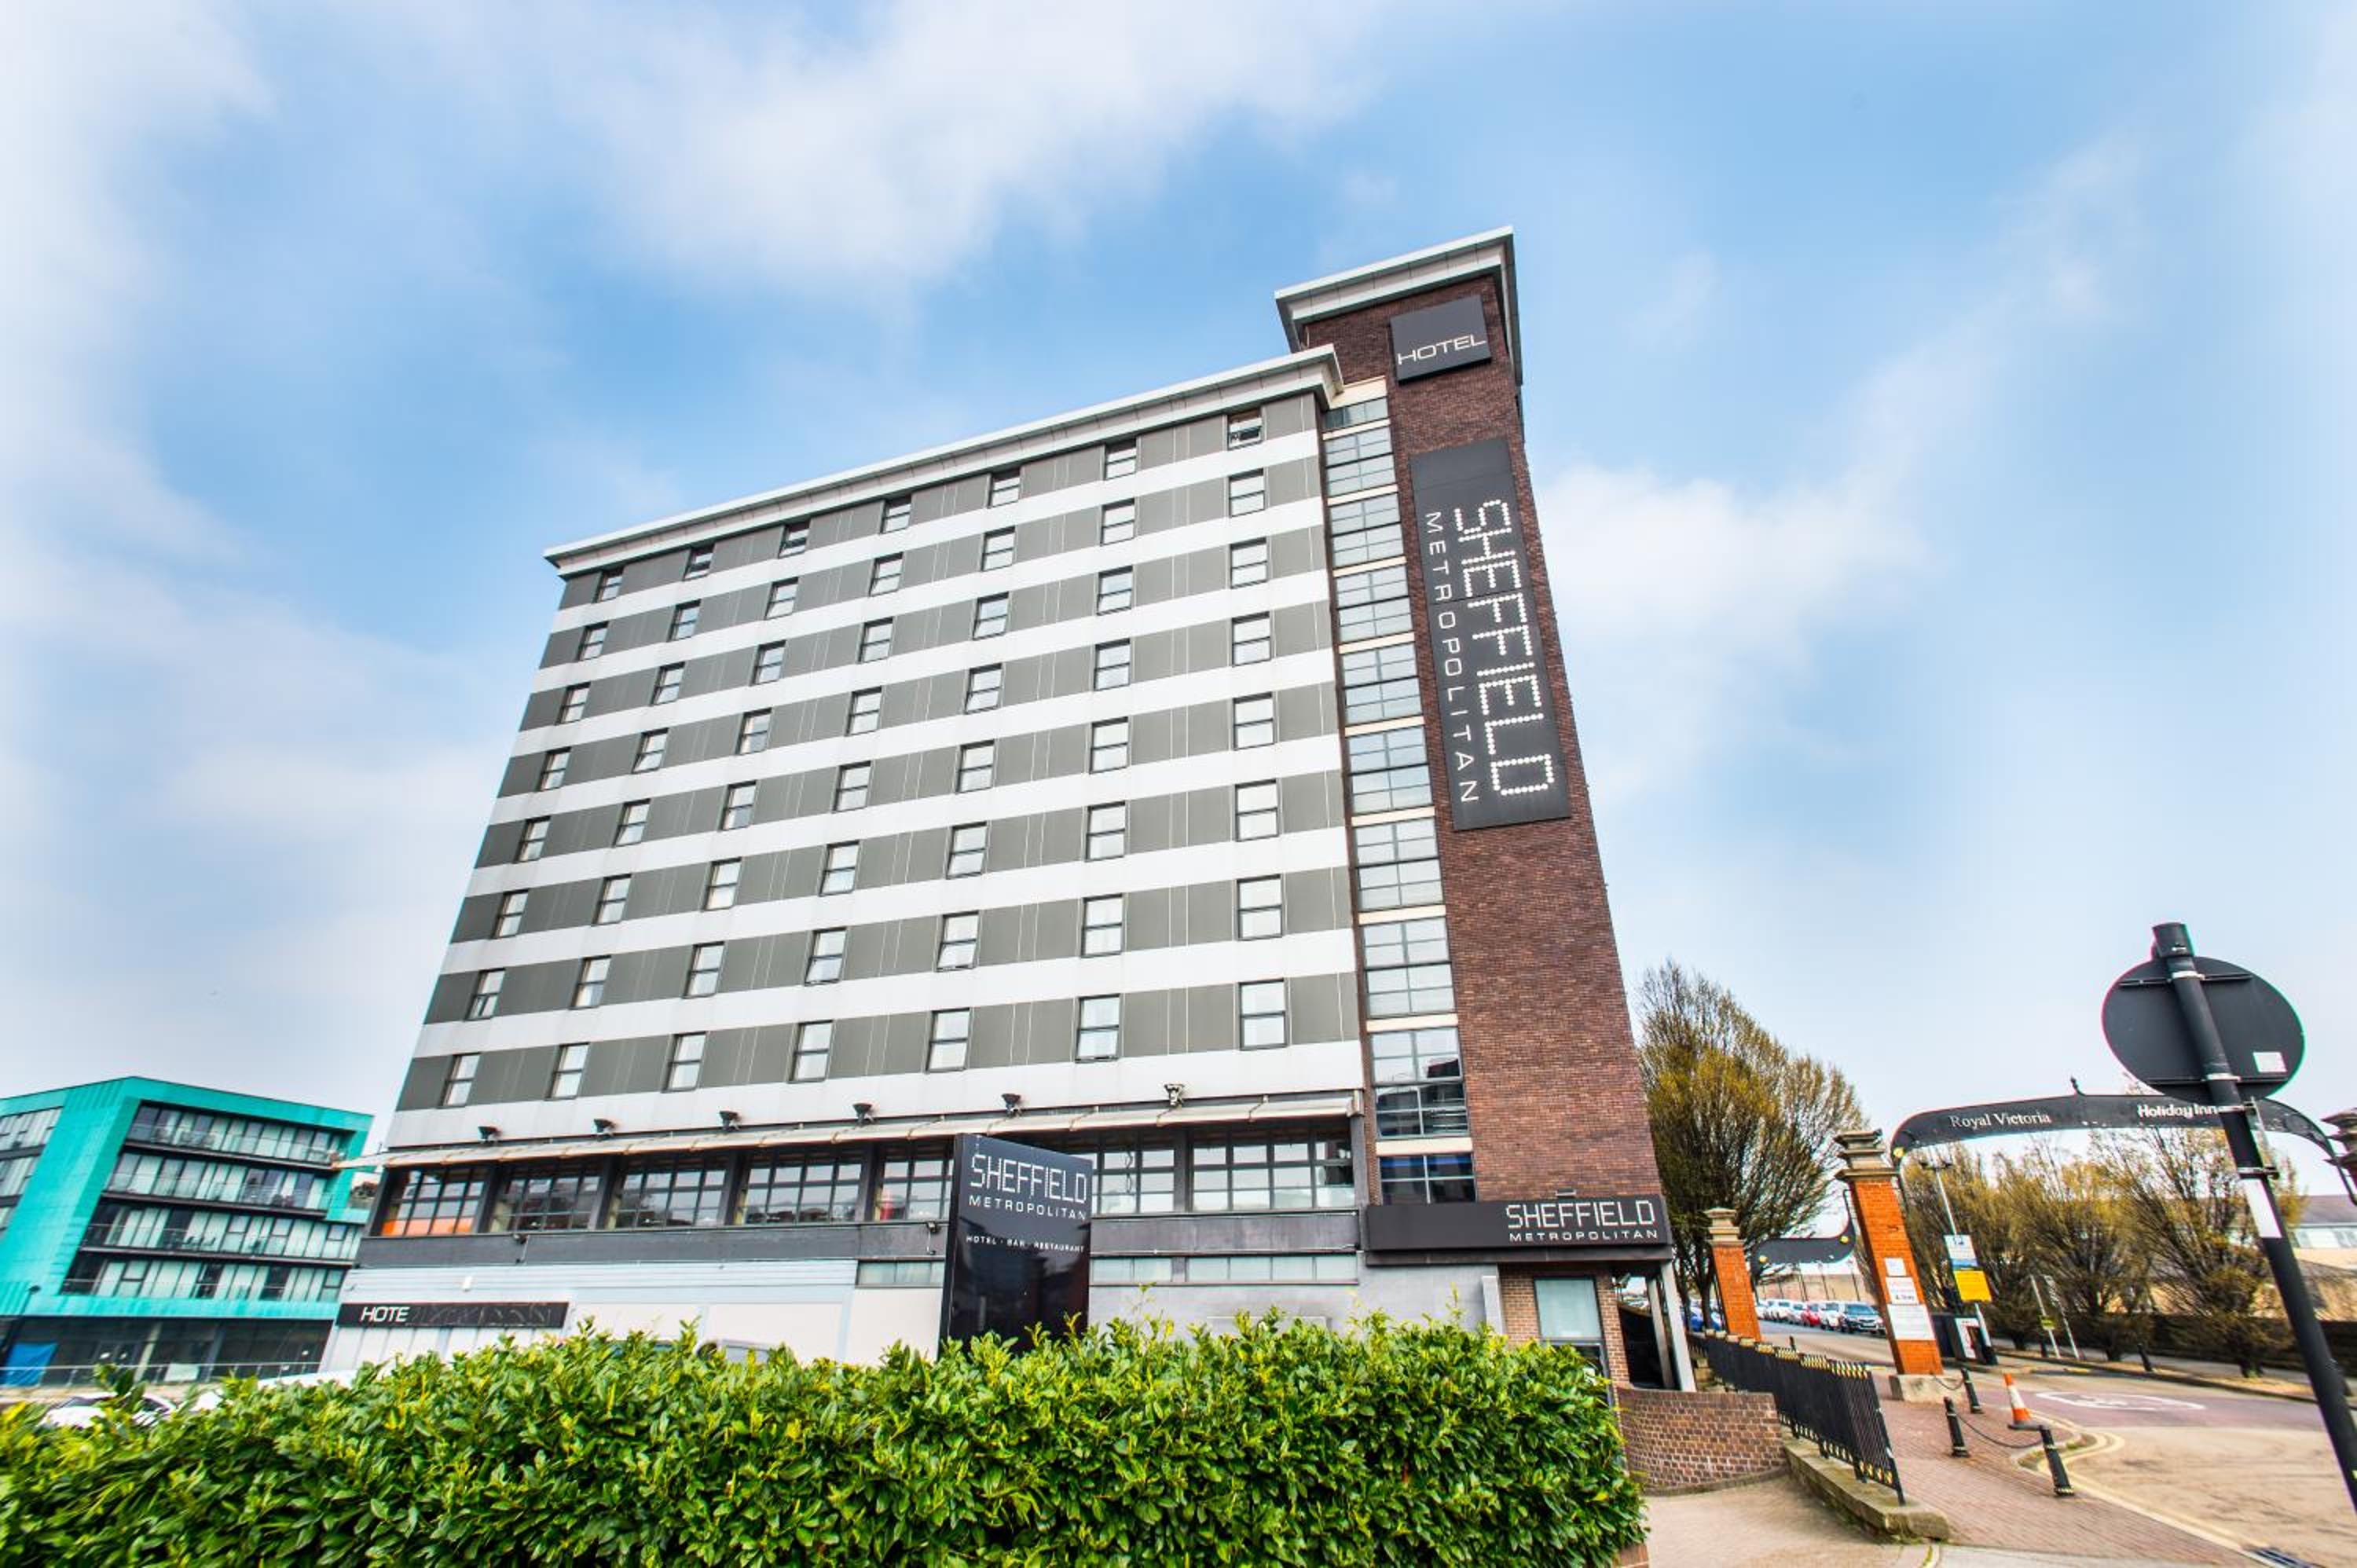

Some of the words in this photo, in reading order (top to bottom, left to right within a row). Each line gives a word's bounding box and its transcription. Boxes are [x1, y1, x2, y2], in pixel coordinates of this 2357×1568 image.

[1397, 334, 1486, 365] HOTEL
[1424, 511, 1480, 804] METROPOLITAN
[1453, 499, 1556, 797] SHEFFIELD
[1949, 1112, 1992, 1130] Royal
[1993, 1111, 2052, 1126] Victoria
[2136, 1104, 2194, 1119] Holiday
[970, 1154, 1087, 1203] SHEFFIELD
[969, 1195, 1086, 1220] METROPOLITAN
[1505, 1200, 1656, 1229] SHEFFIELD
[966, 1236, 996, 1245] HOTEL
[1034, 1241, 1084, 1253] RESTAURANT
[1509, 1230, 1659, 1242] METROPOLITAN
